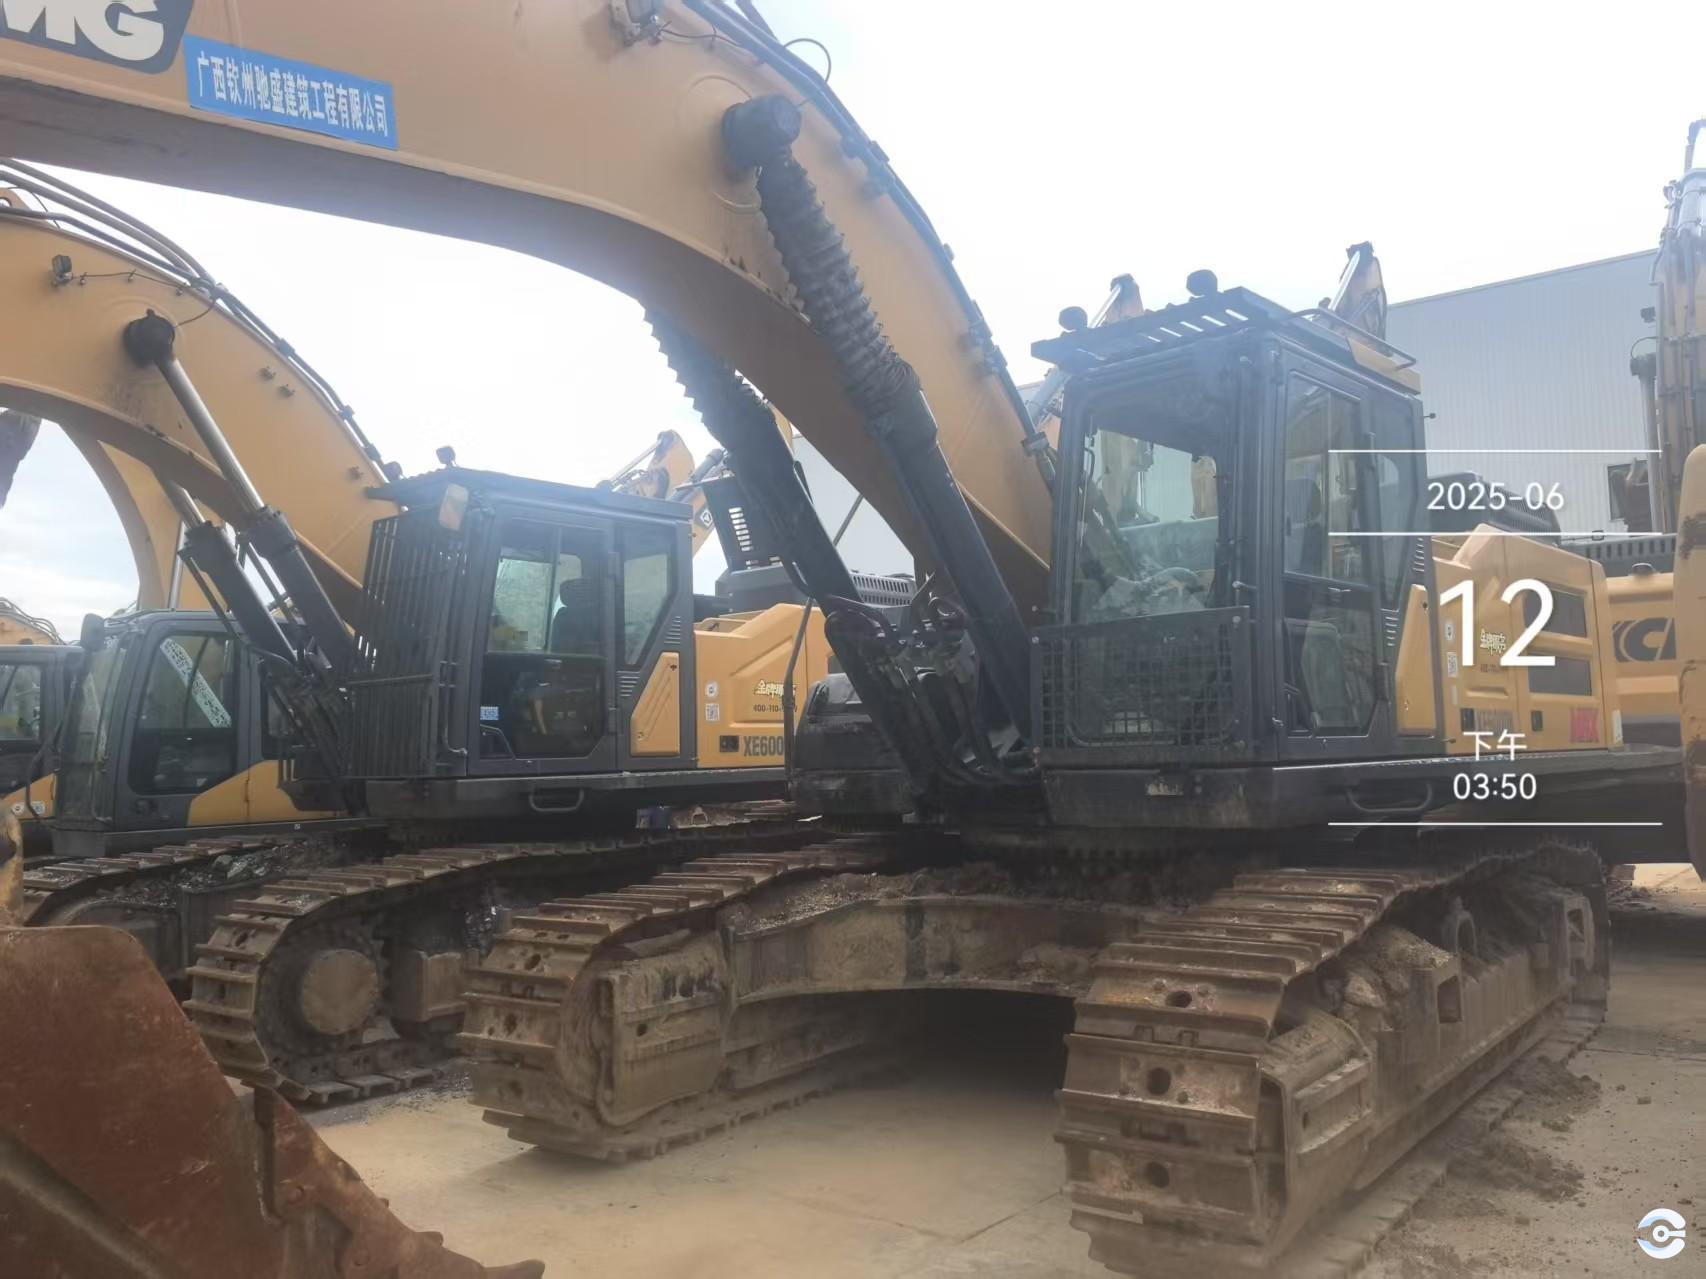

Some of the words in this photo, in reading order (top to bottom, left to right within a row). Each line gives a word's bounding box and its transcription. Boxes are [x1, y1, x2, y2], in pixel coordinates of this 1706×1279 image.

[197, 50, 389, 137] 广西钦州驰盛建筑工程有限公司
[743, 735, 784, 757] XE600
